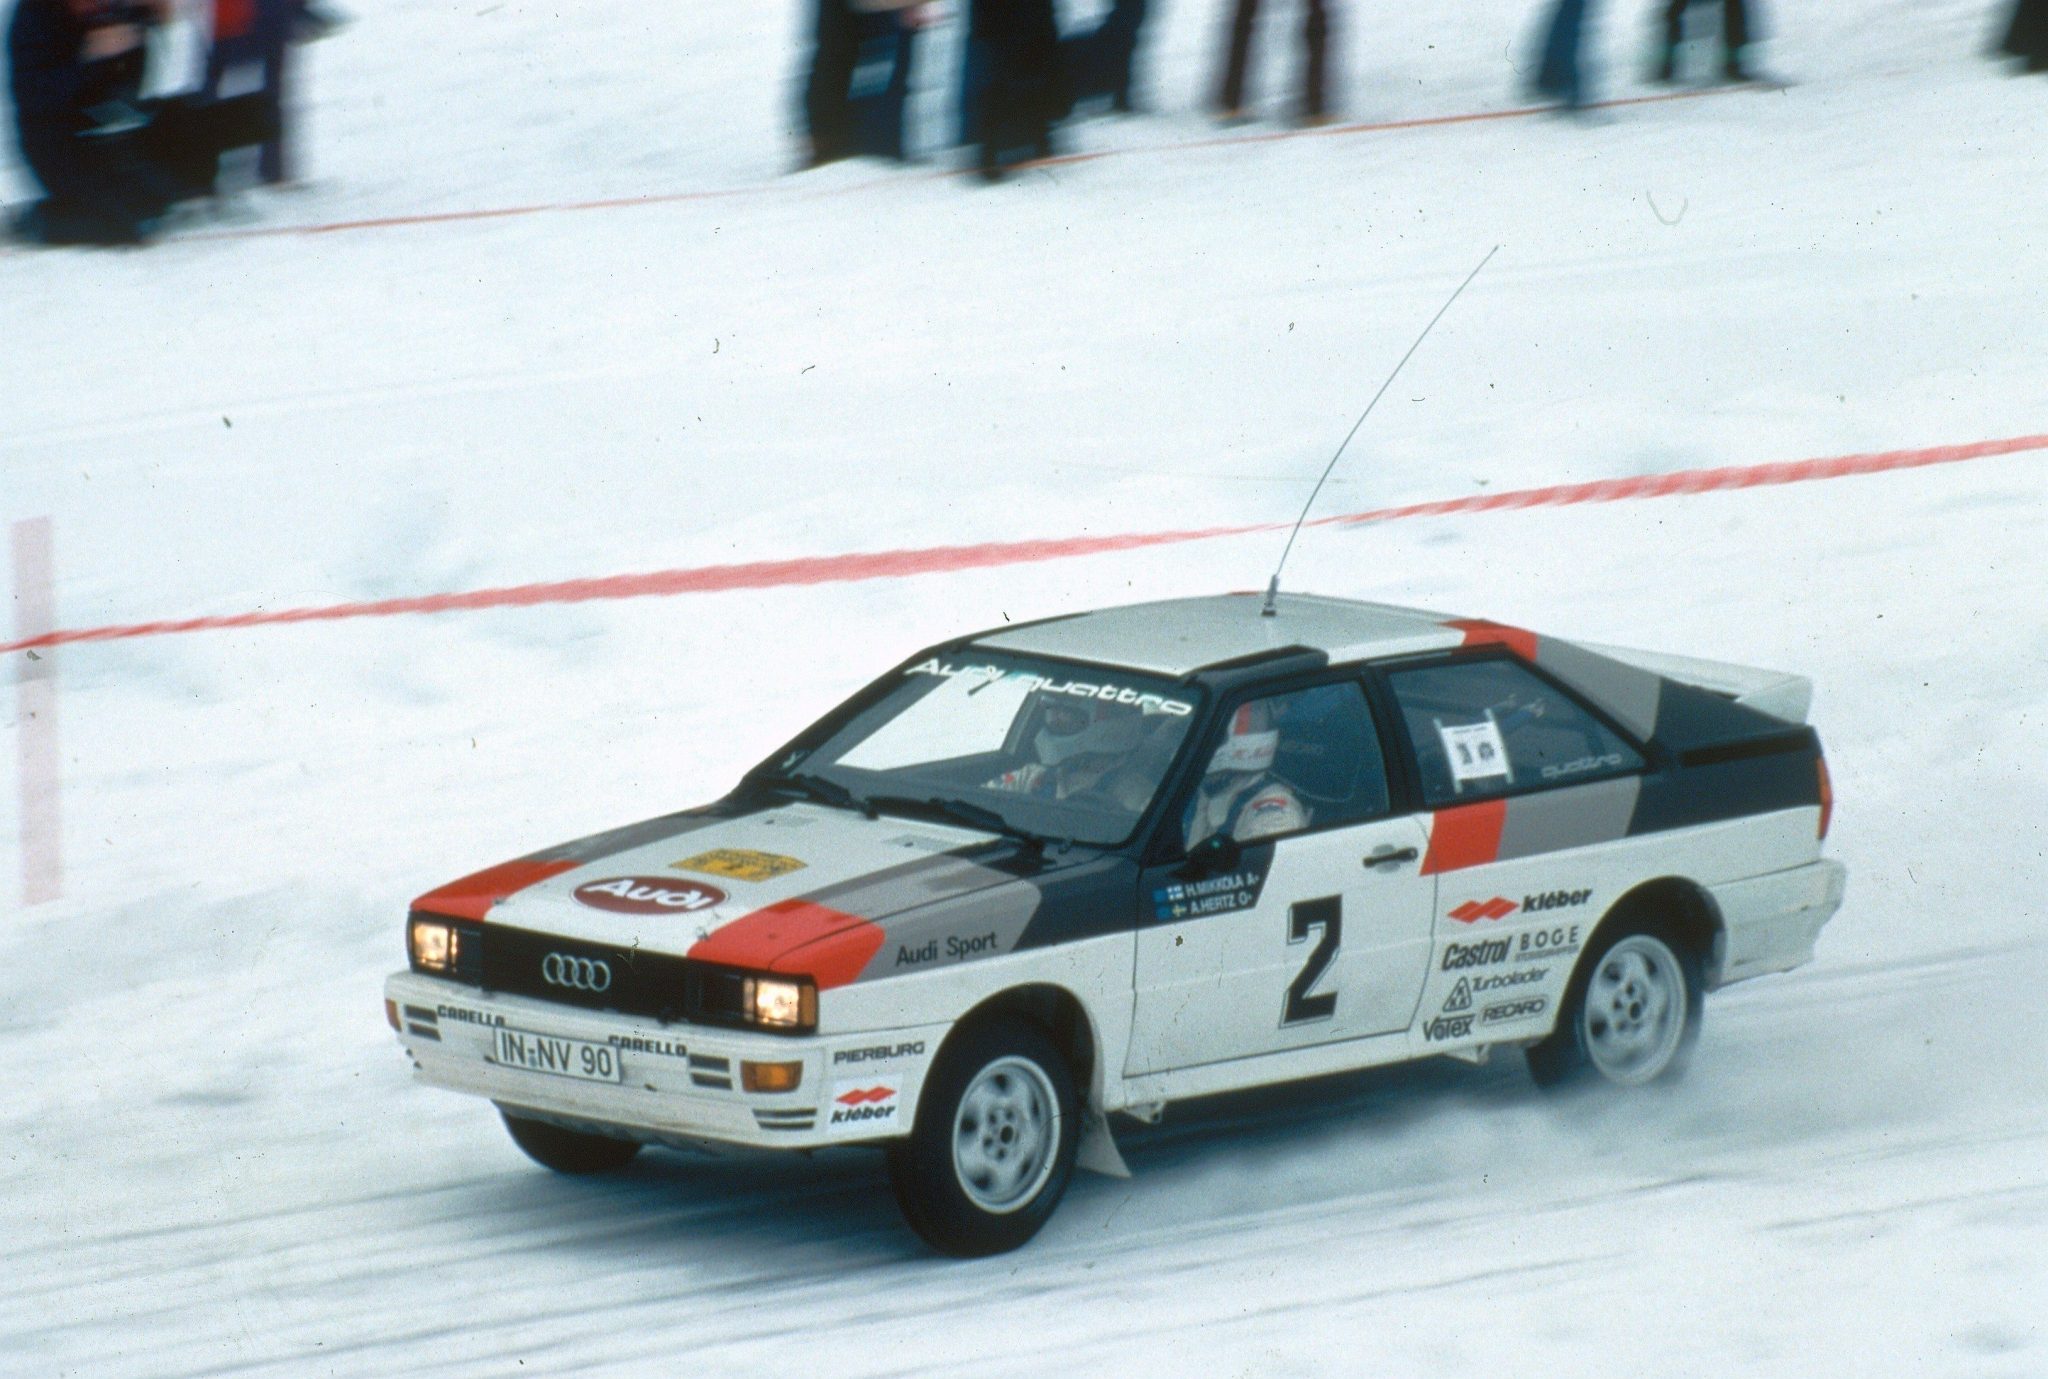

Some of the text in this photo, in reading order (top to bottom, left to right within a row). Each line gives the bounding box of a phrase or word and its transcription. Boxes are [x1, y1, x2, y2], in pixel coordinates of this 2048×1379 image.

[1540, 753, 1623, 778] quattro
[582, 879, 714, 910] Audi
[895, 931, 999, 967] Audi Sport
[1519, 924, 1580, 951] BOGE
[1278, 893, 1343, 1030] 2
[1441, 935, 1513, 972] Castrol
[1472, 967, 1550, 992] Turbolader
[437, 1004, 505, 1027] CARELLO
[1481, 998, 1546, 1021] RECARO
[608, 1034, 688, 1057] CARELLO
[833, 1041, 925, 1065] PIERBURG
